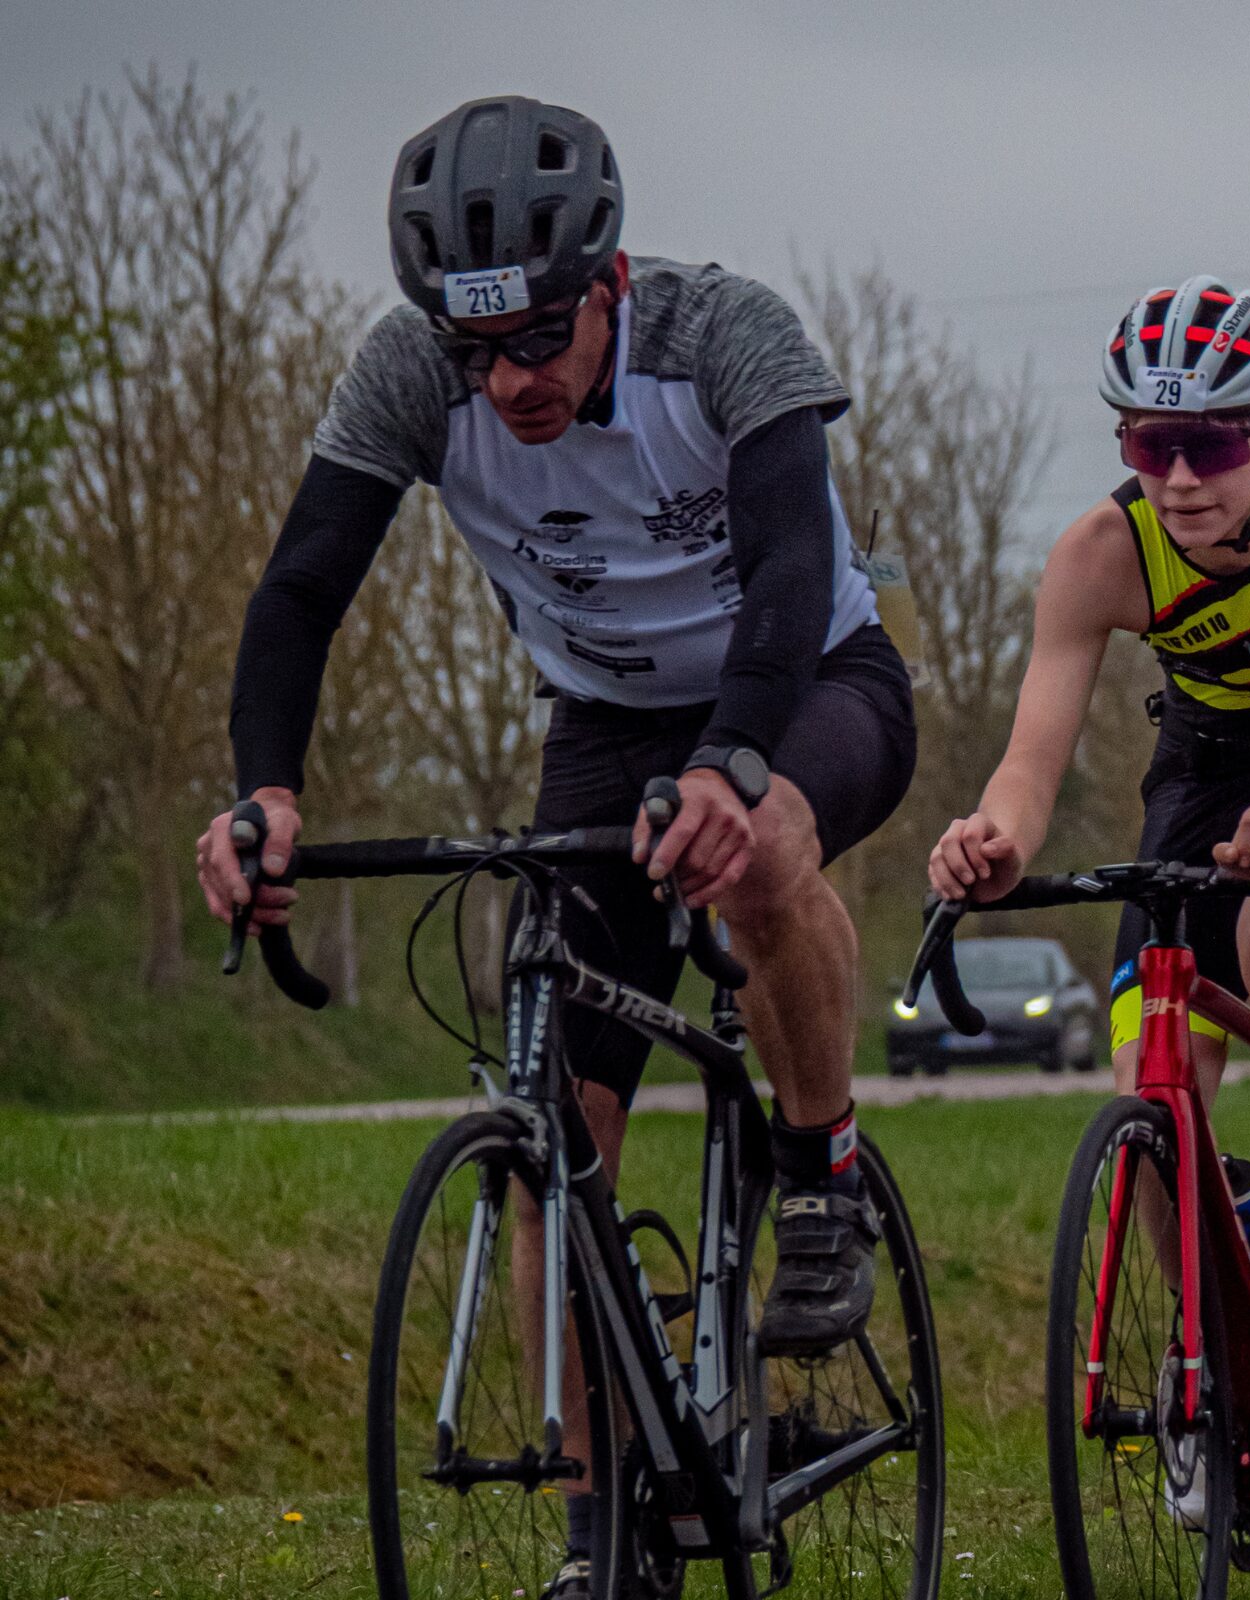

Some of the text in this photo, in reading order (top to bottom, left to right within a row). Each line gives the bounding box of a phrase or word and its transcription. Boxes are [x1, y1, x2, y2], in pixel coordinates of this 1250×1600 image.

[466, 284, 506, 315] 213
[1147, 369, 1184, 379] Running
[1154, 379, 1182, 407] 29
[1181, 622, 1212, 647] TRI
[1207, 612, 1231, 634] 10
[526, 973, 553, 1077] TREK
